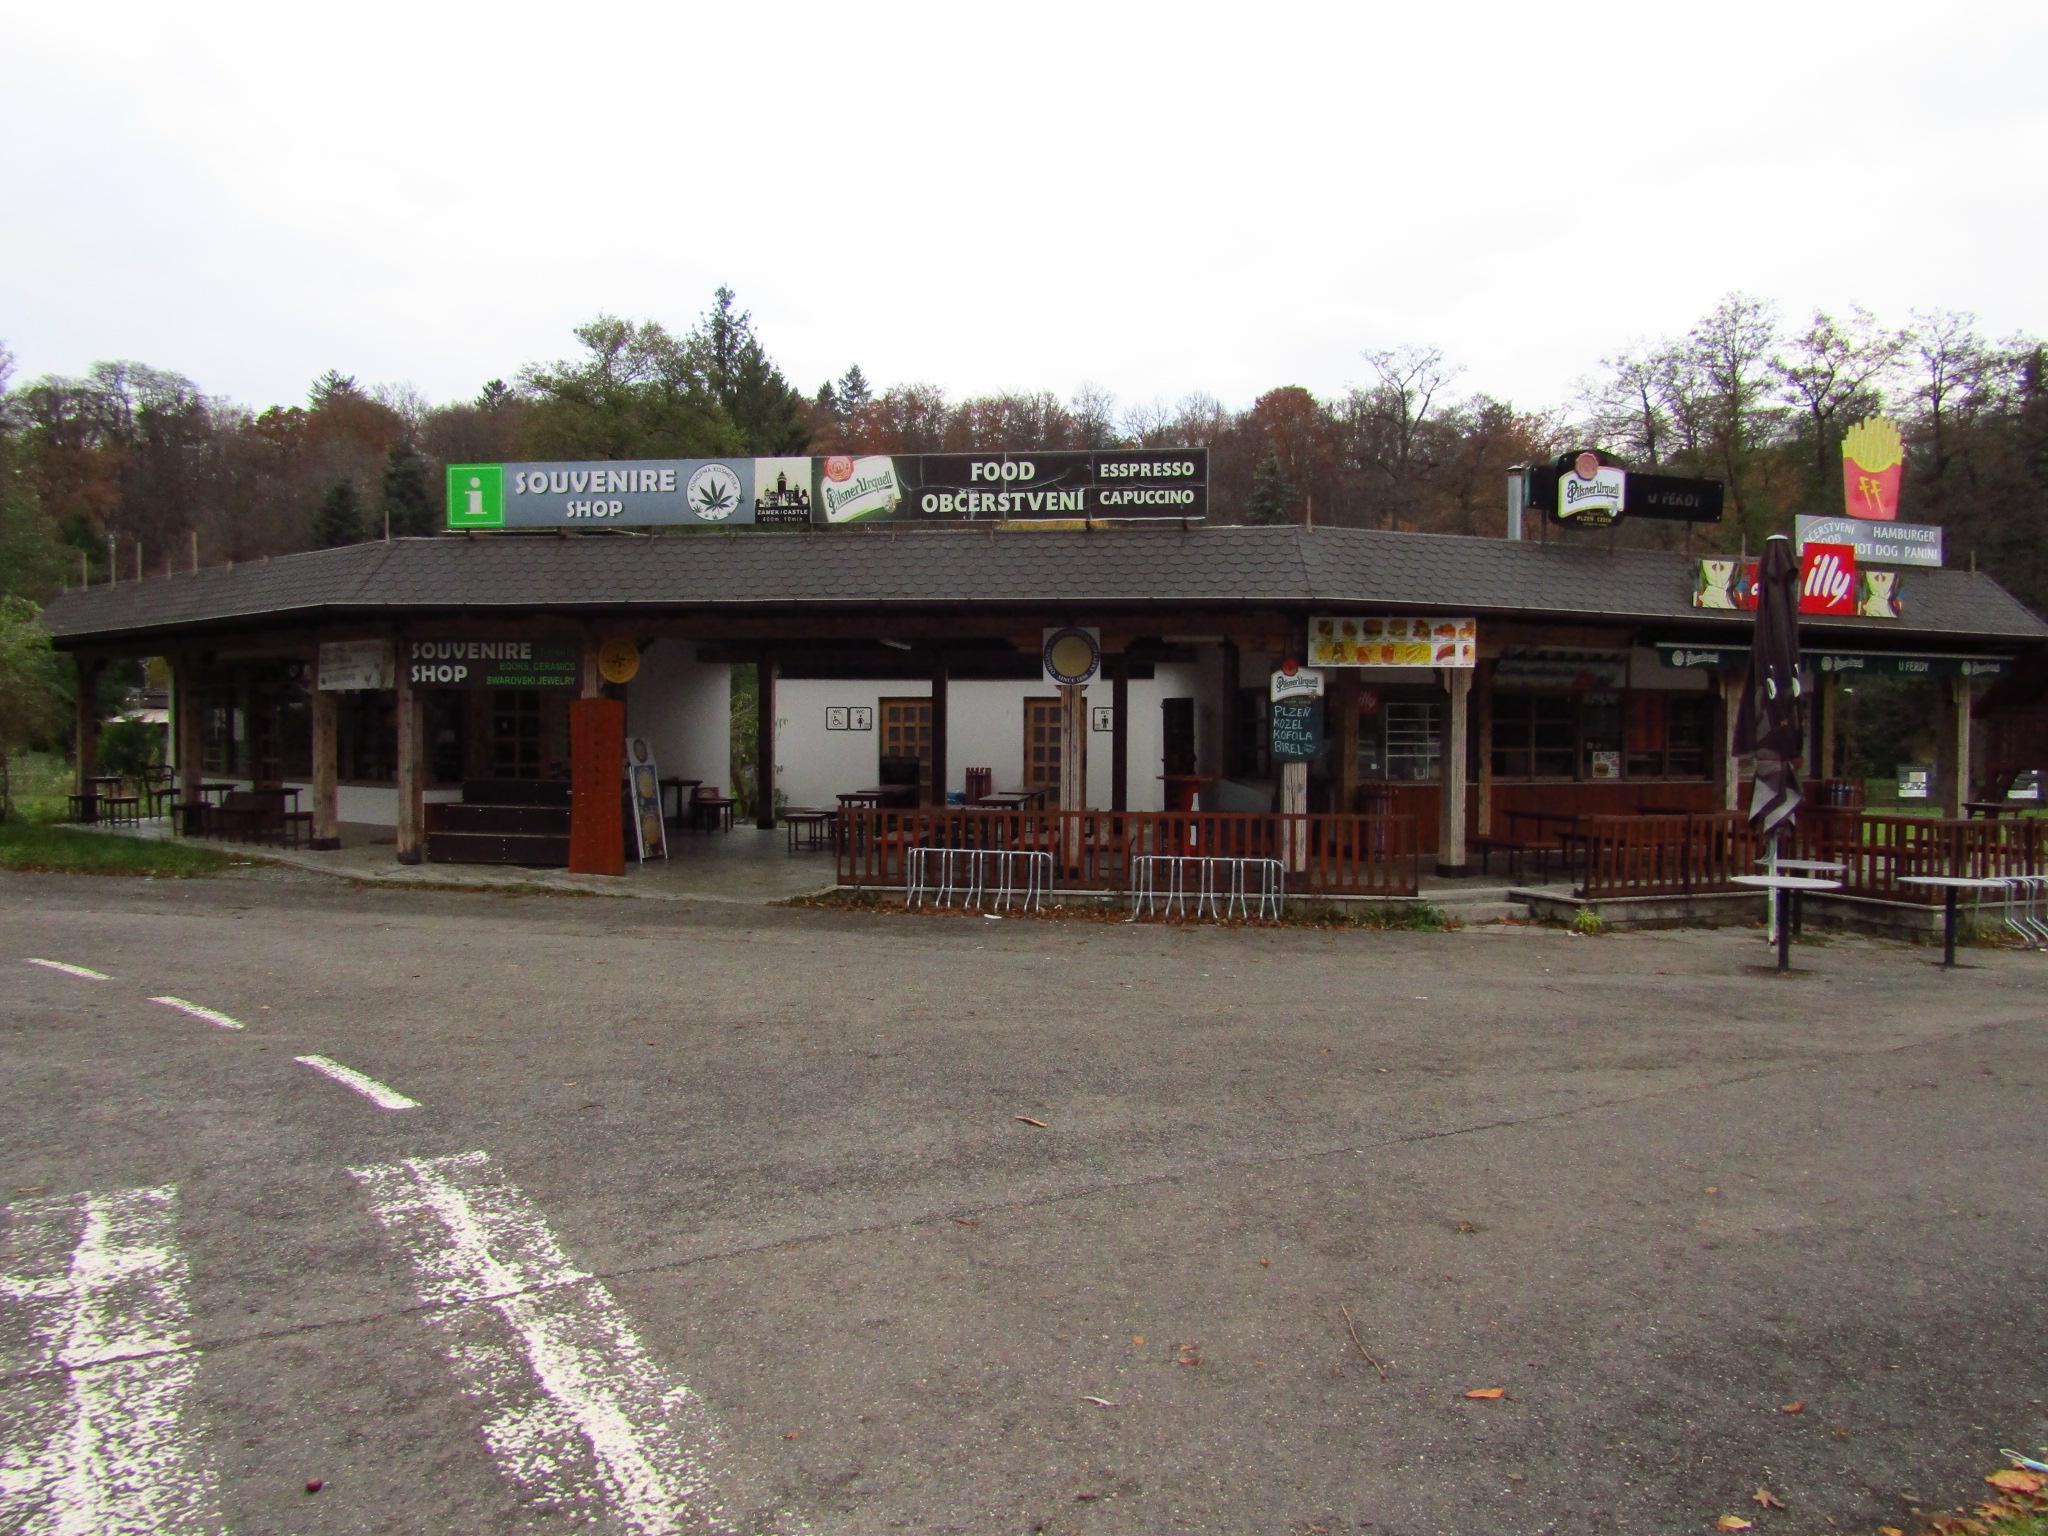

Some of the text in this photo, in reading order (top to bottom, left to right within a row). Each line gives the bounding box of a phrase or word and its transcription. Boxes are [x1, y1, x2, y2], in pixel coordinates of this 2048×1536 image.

[971, 462, 1035, 482] FOOD
[1100, 462, 1195, 478] ESSPRESSO
[515, 469, 676, 494] SOUVENIRE
[826, 471, 892, 514] Pilsner Urquell
[921, 487, 1084, 513] OBČERSTVENÍ
[1100, 490, 1194, 505] CAPUCCINO
[1567, 480, 1619, 504] Pilsner Urquell
[566, 500, 623, 518] SHOP
[1873, 527, 1935, 543] HAMBURGER
[1875, 545, 1898, 557] DOG
[1904, 546, 1938, 560] PANINI
[1804, 554, 1850, 607] illy
[411, 641, 532, 659] SOUVENIRE
[411, 665, 468, 683] SHOP
[486, 675, 576, 686] SWAROVSKI JEWELRY
[1273, 717, 1304, 729] KOZEL
[1273, 729, 1312, 741] KOFOLA
[1274, 741, 1304, 755] BIREL
